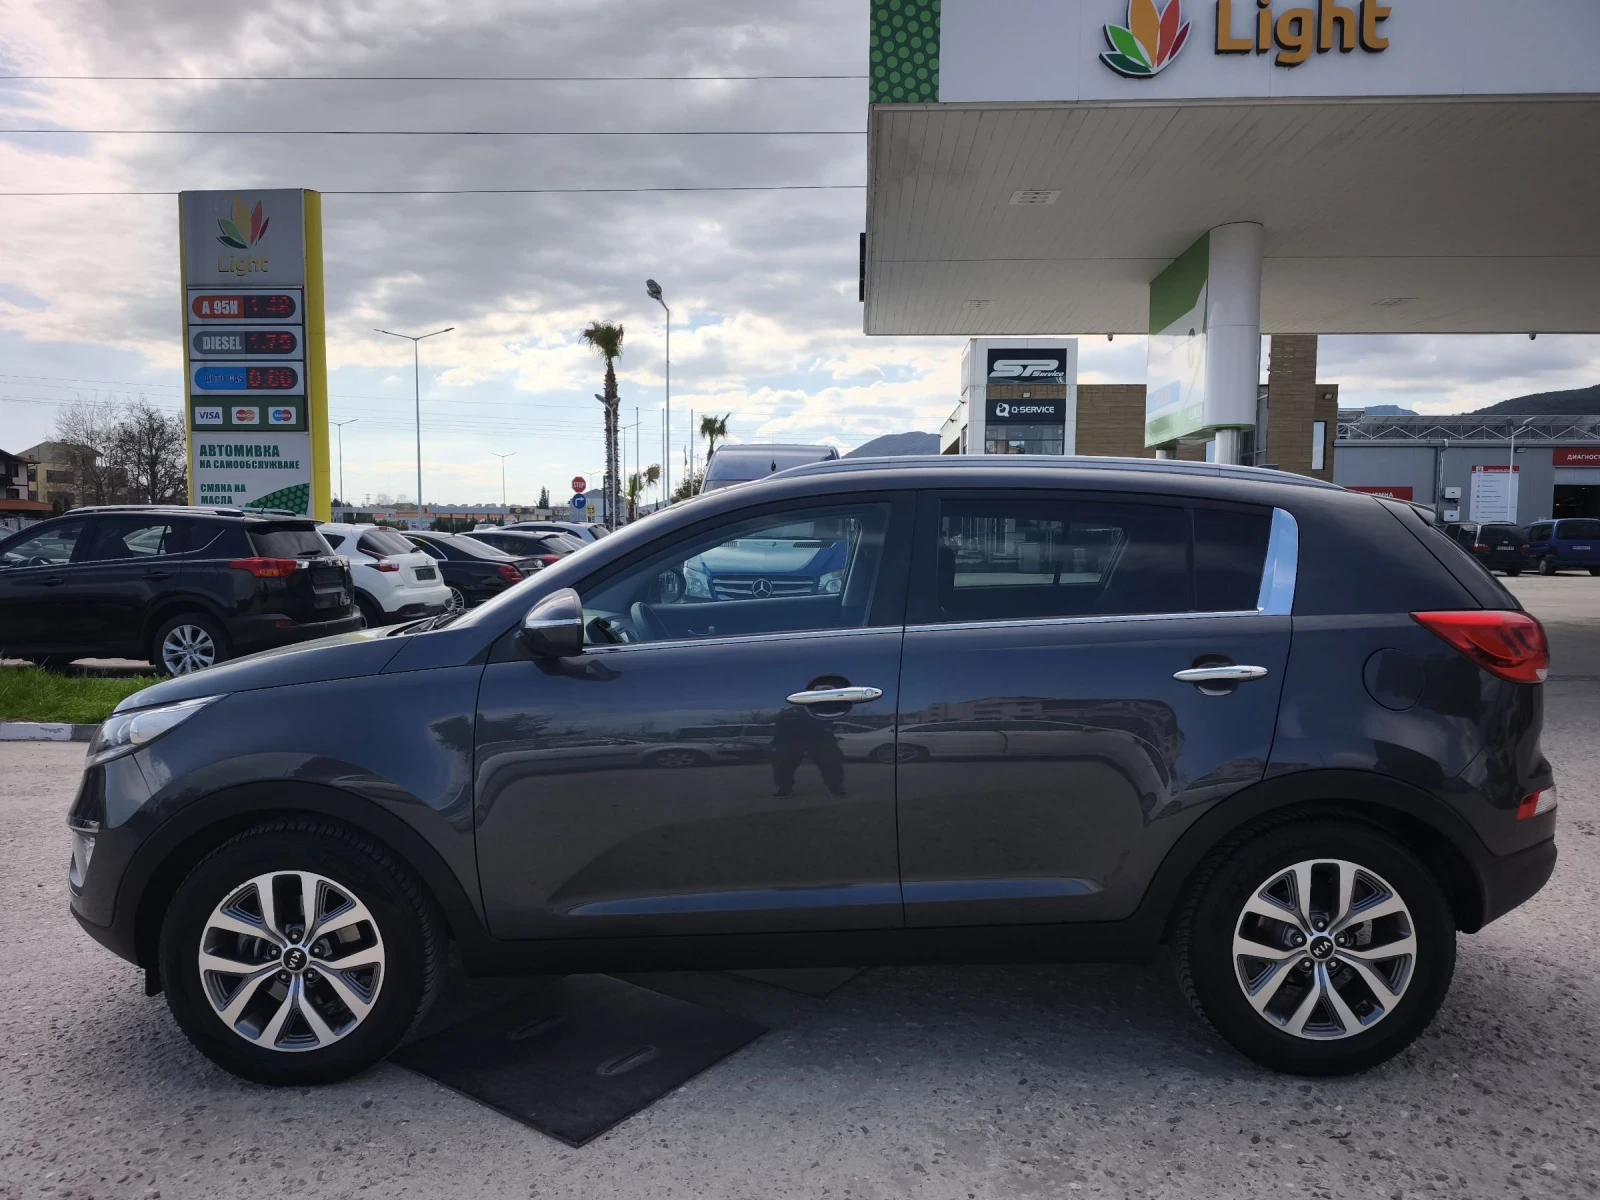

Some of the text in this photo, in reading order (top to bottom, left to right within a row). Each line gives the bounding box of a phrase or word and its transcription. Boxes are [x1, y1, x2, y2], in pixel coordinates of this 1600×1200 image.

[1214, 0, 1392, 67] Light
[217, 253, 269, 276] Light
[202, 335, 242, 350] DIESEL
[989, 359, 1060, 377] SP
[199, 411, 221, 420] VISA
[199, 444, 281, 458] АВТОМИВКА
[199, 460, 301, 470] НА САМООБСЛУЖВАНЕ
[200, 484, 247, 493] СМЯНА НА
[573, 481, 585, 489] STOP
[200, 495, 234, 505] МАСЛА
[1313, 941, 1331, 956] KIA
[288, 950, 301, 968] KIA
